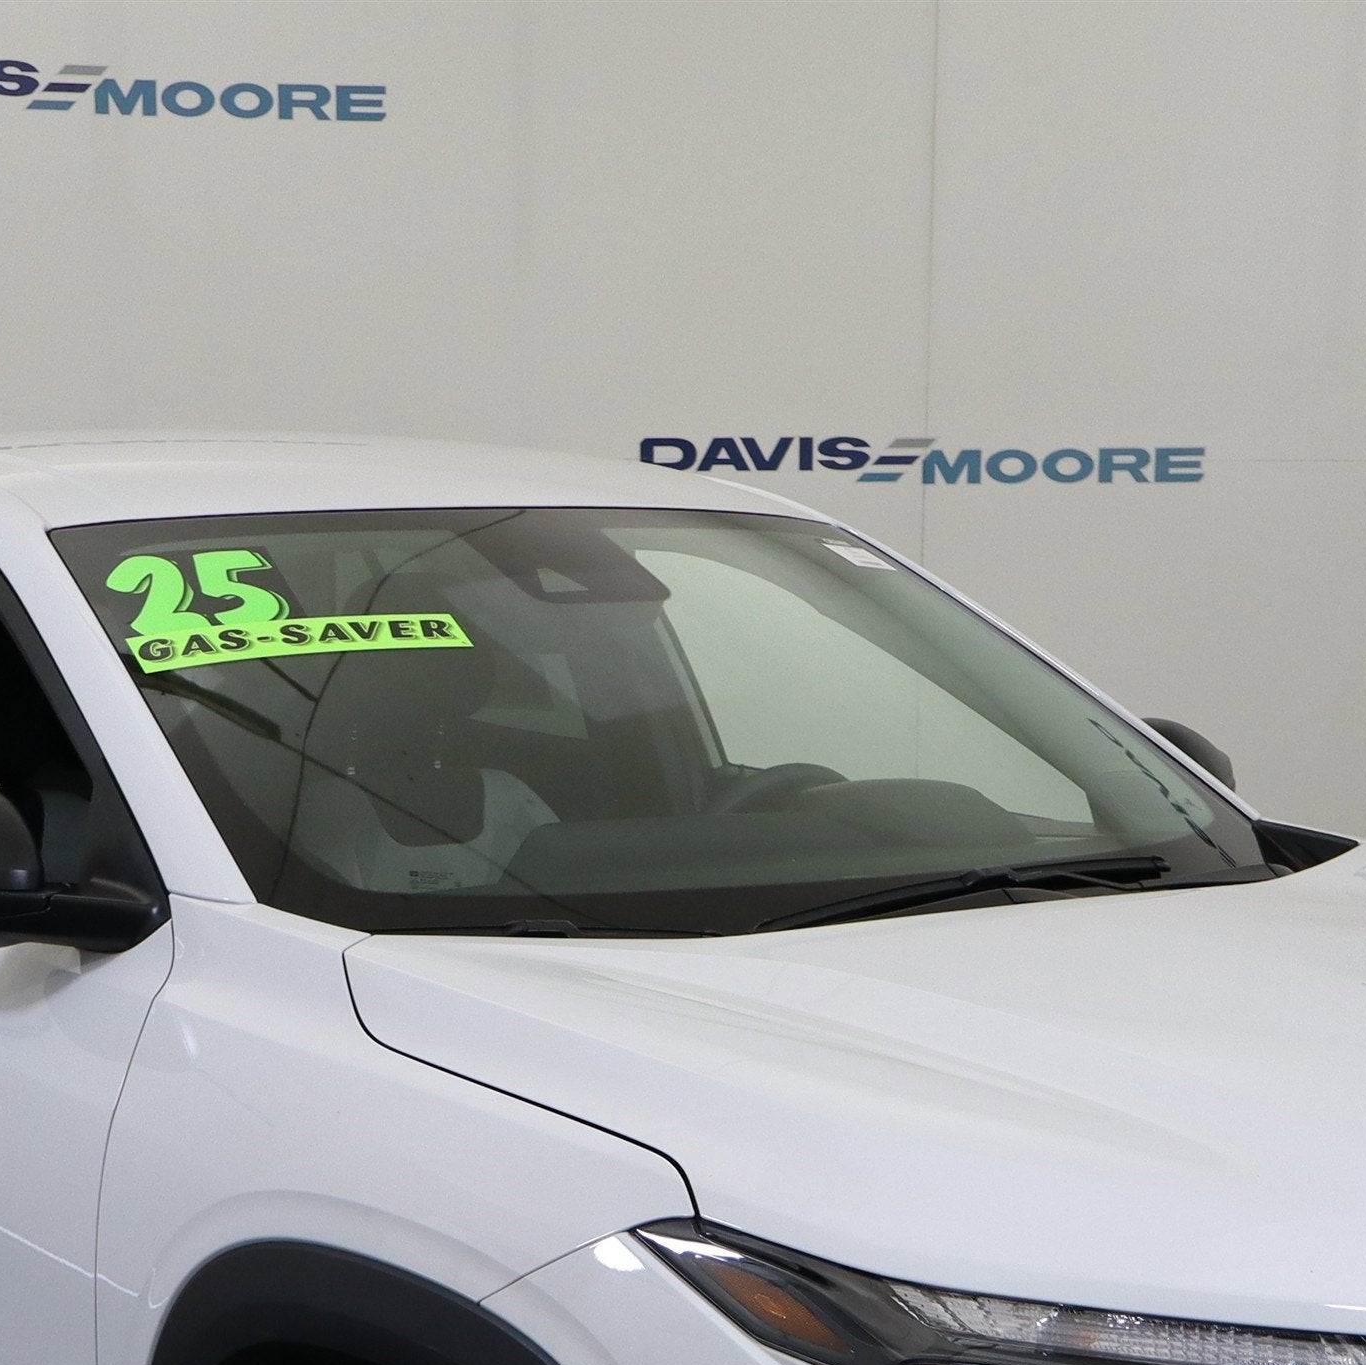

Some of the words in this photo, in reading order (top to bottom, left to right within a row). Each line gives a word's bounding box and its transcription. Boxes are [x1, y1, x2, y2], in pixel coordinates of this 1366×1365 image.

[94, 79, 387, 122] MOORE
[639, 436, 870, 472] DAVIS
[922, 448, 1206, 485] MOORE
[106, 550, 290, 636] 25
[138, 618, 455, 661] GAS-SAVER
